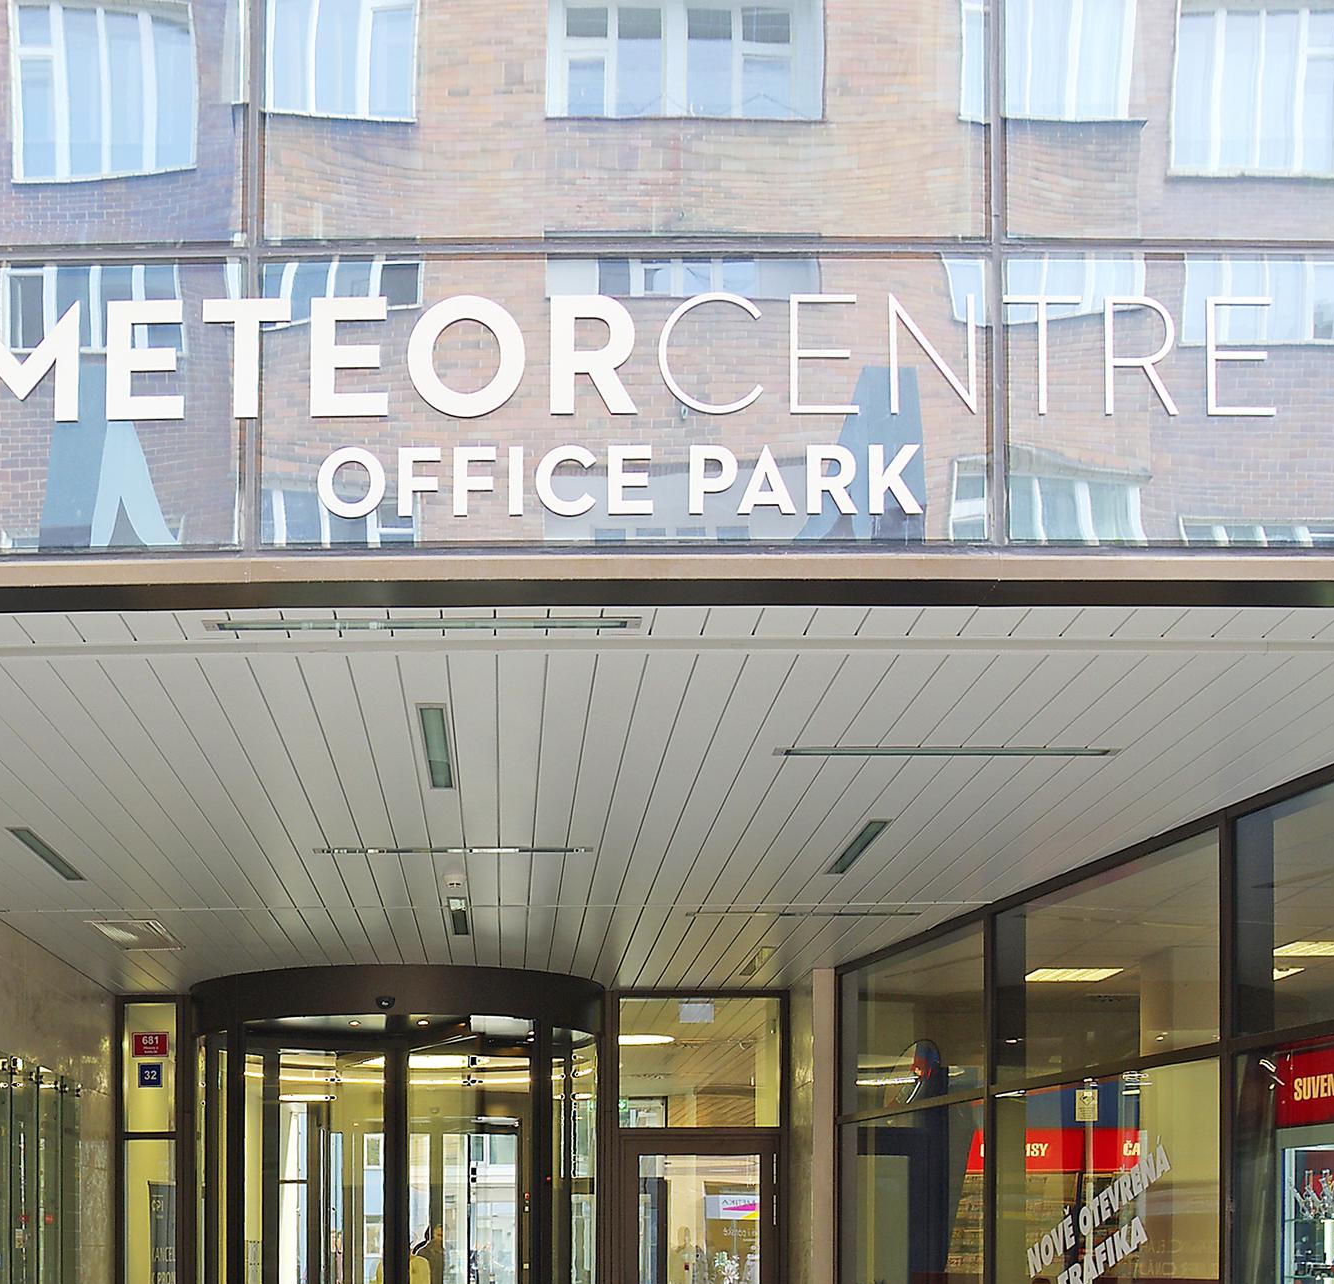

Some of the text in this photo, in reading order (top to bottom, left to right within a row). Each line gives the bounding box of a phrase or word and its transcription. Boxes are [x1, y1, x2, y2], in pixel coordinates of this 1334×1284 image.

[317, 443, 927, 519] OFFICE PARK
[142, 1035, 159, 1045] 681
[144, 1070, 157, 1080] 32
[1027, 1205, 1076, 1279] NOVĚ
[1079, 1135, 1171, 1237] OTEVŘENÁ
